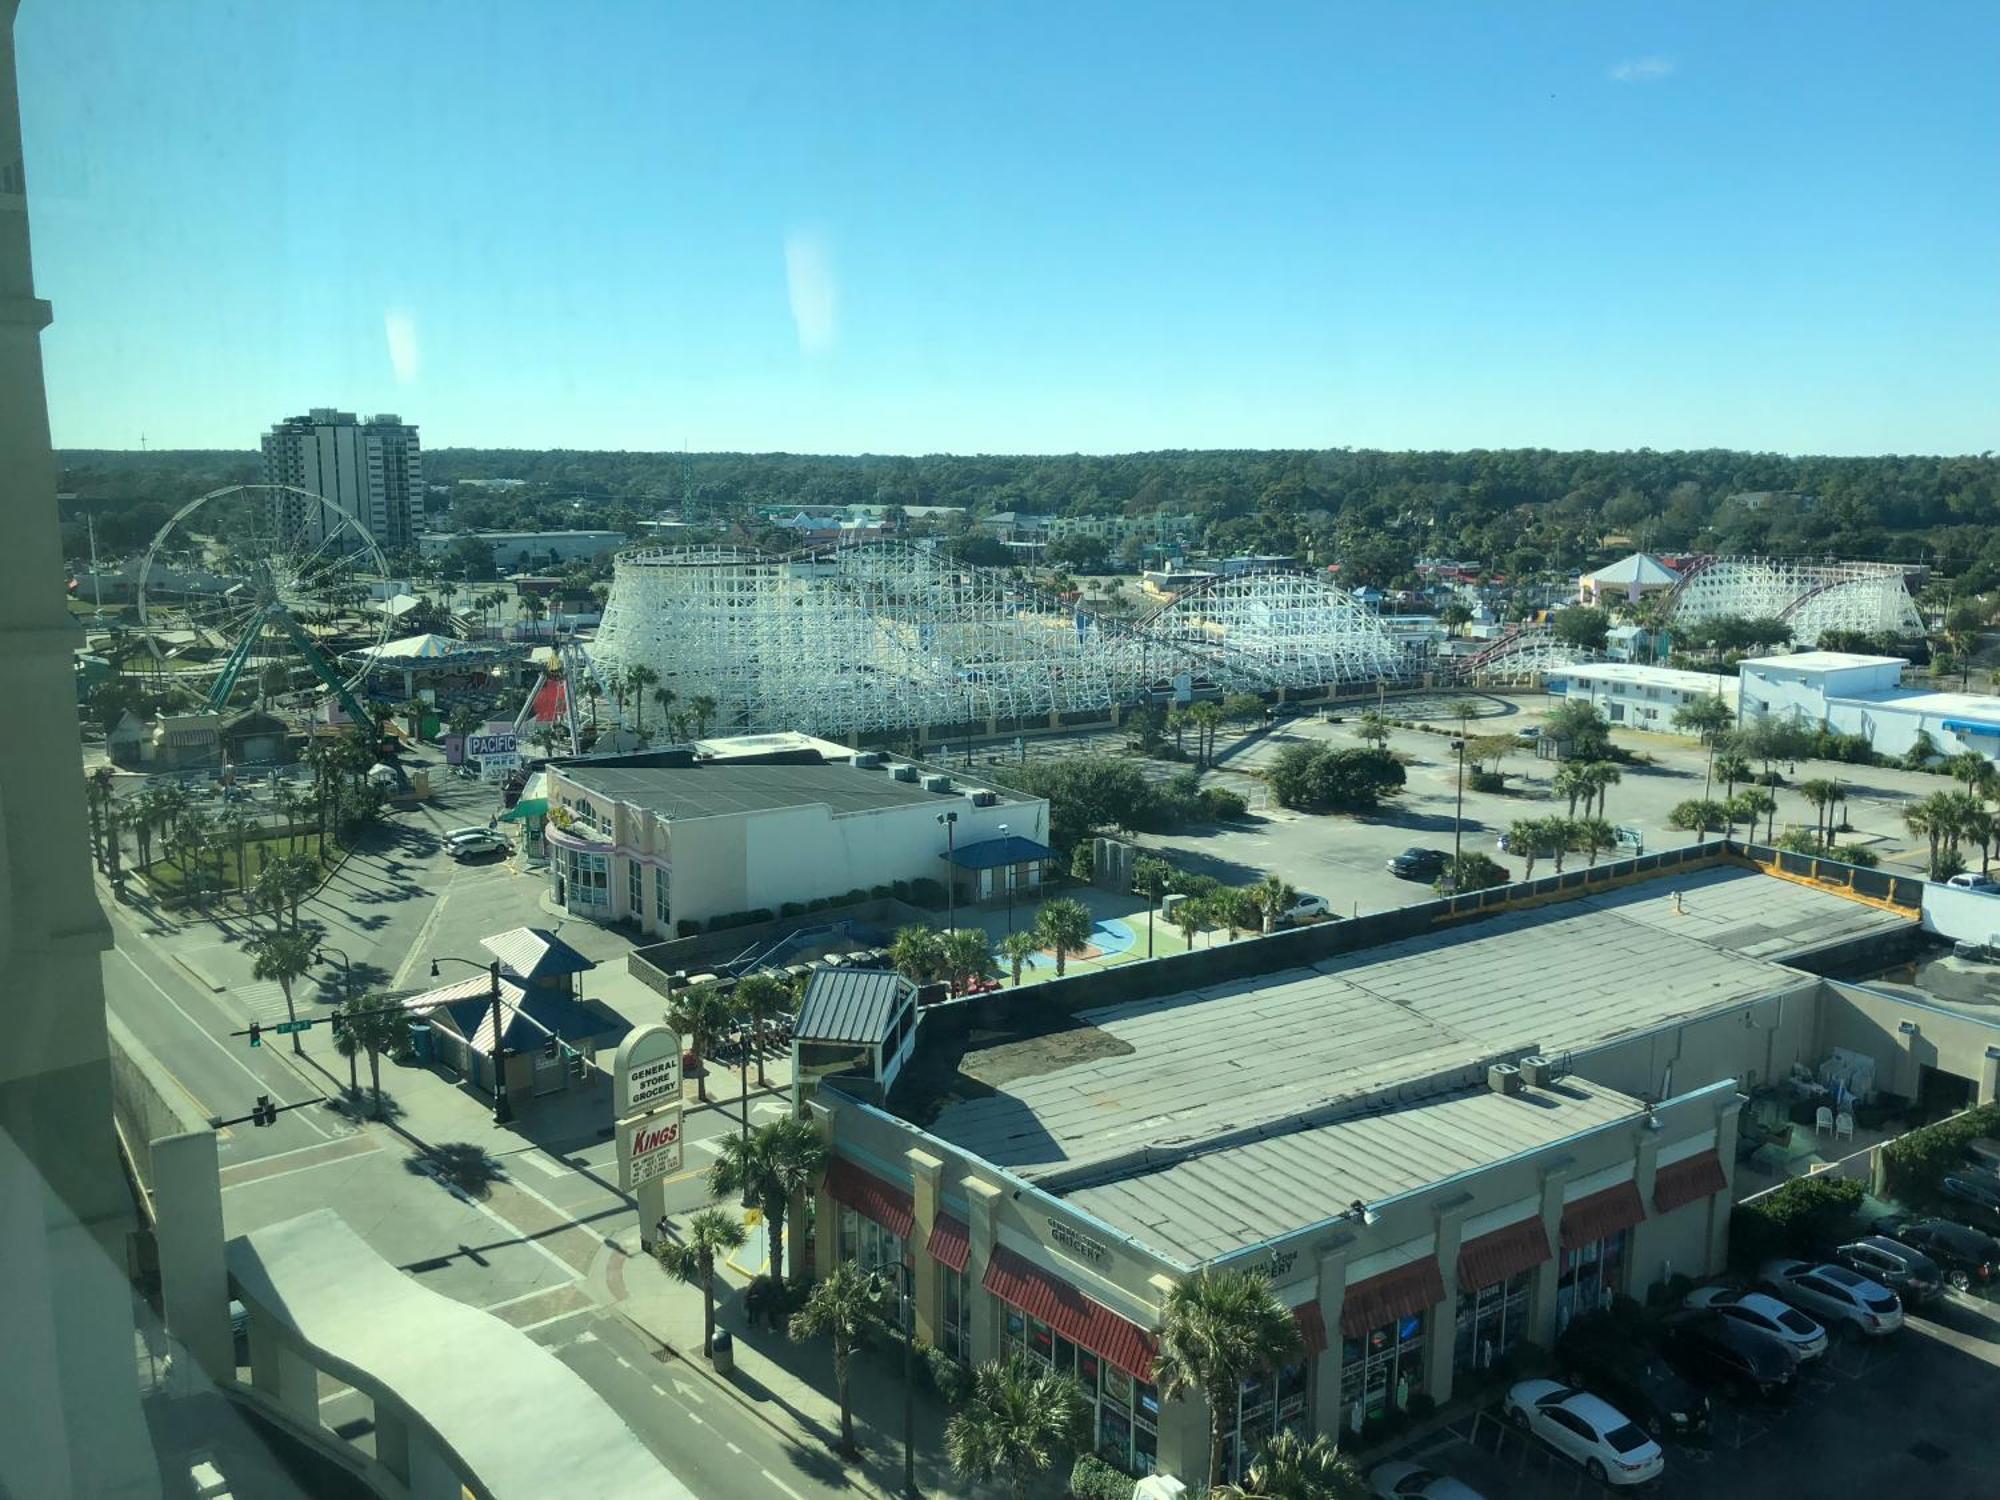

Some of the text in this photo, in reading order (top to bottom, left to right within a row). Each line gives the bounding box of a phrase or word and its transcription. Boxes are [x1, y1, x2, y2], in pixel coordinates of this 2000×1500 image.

[472, 735, 516, 754] PACIFIC
[631, 1060, 677, 1081] GENERAL
[640, 1072, 670, 1090] STORE
[632, 1081, 676, 1103] GROCERY
[632, 1123, 678, 1156] KINGS
[1051, 1228, 1102, 1262] GROCERY
